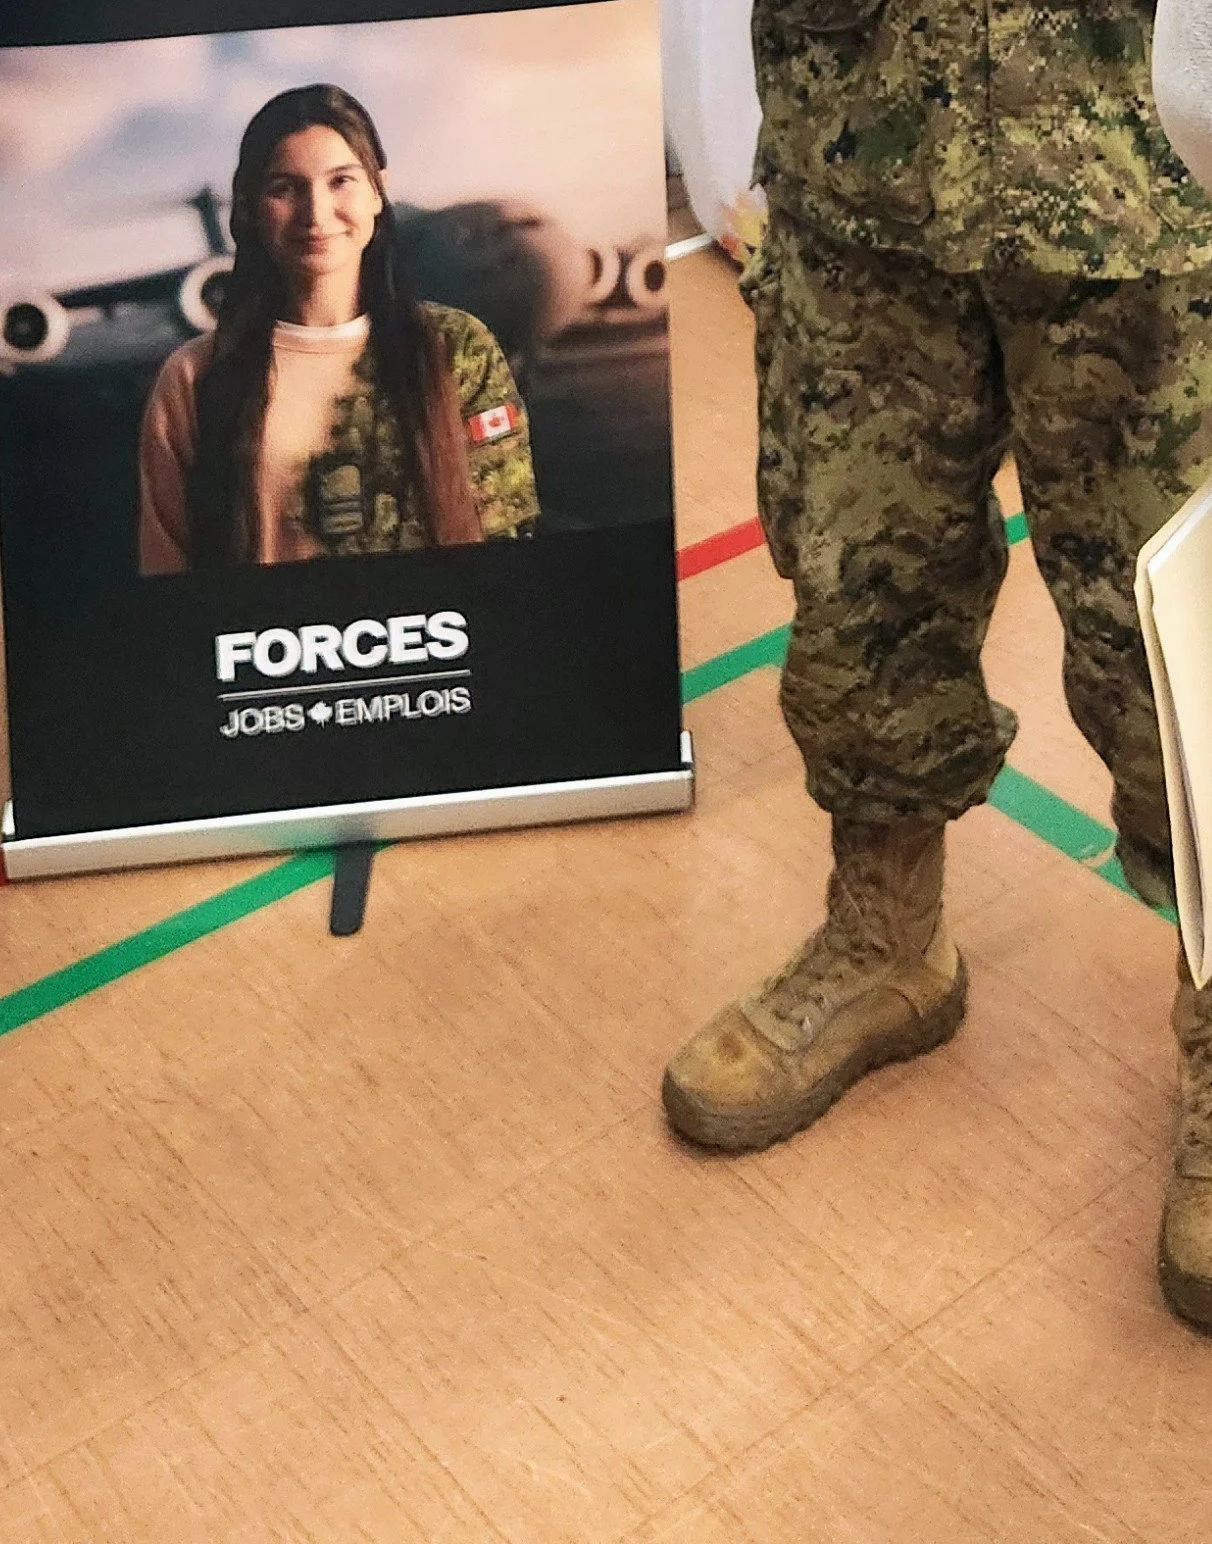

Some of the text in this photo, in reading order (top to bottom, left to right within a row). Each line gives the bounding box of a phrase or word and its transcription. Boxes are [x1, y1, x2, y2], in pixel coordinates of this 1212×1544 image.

[215, 611, 470, 683] FORCES
[219, 687, 472, 739] JOBS EMPLOIS
